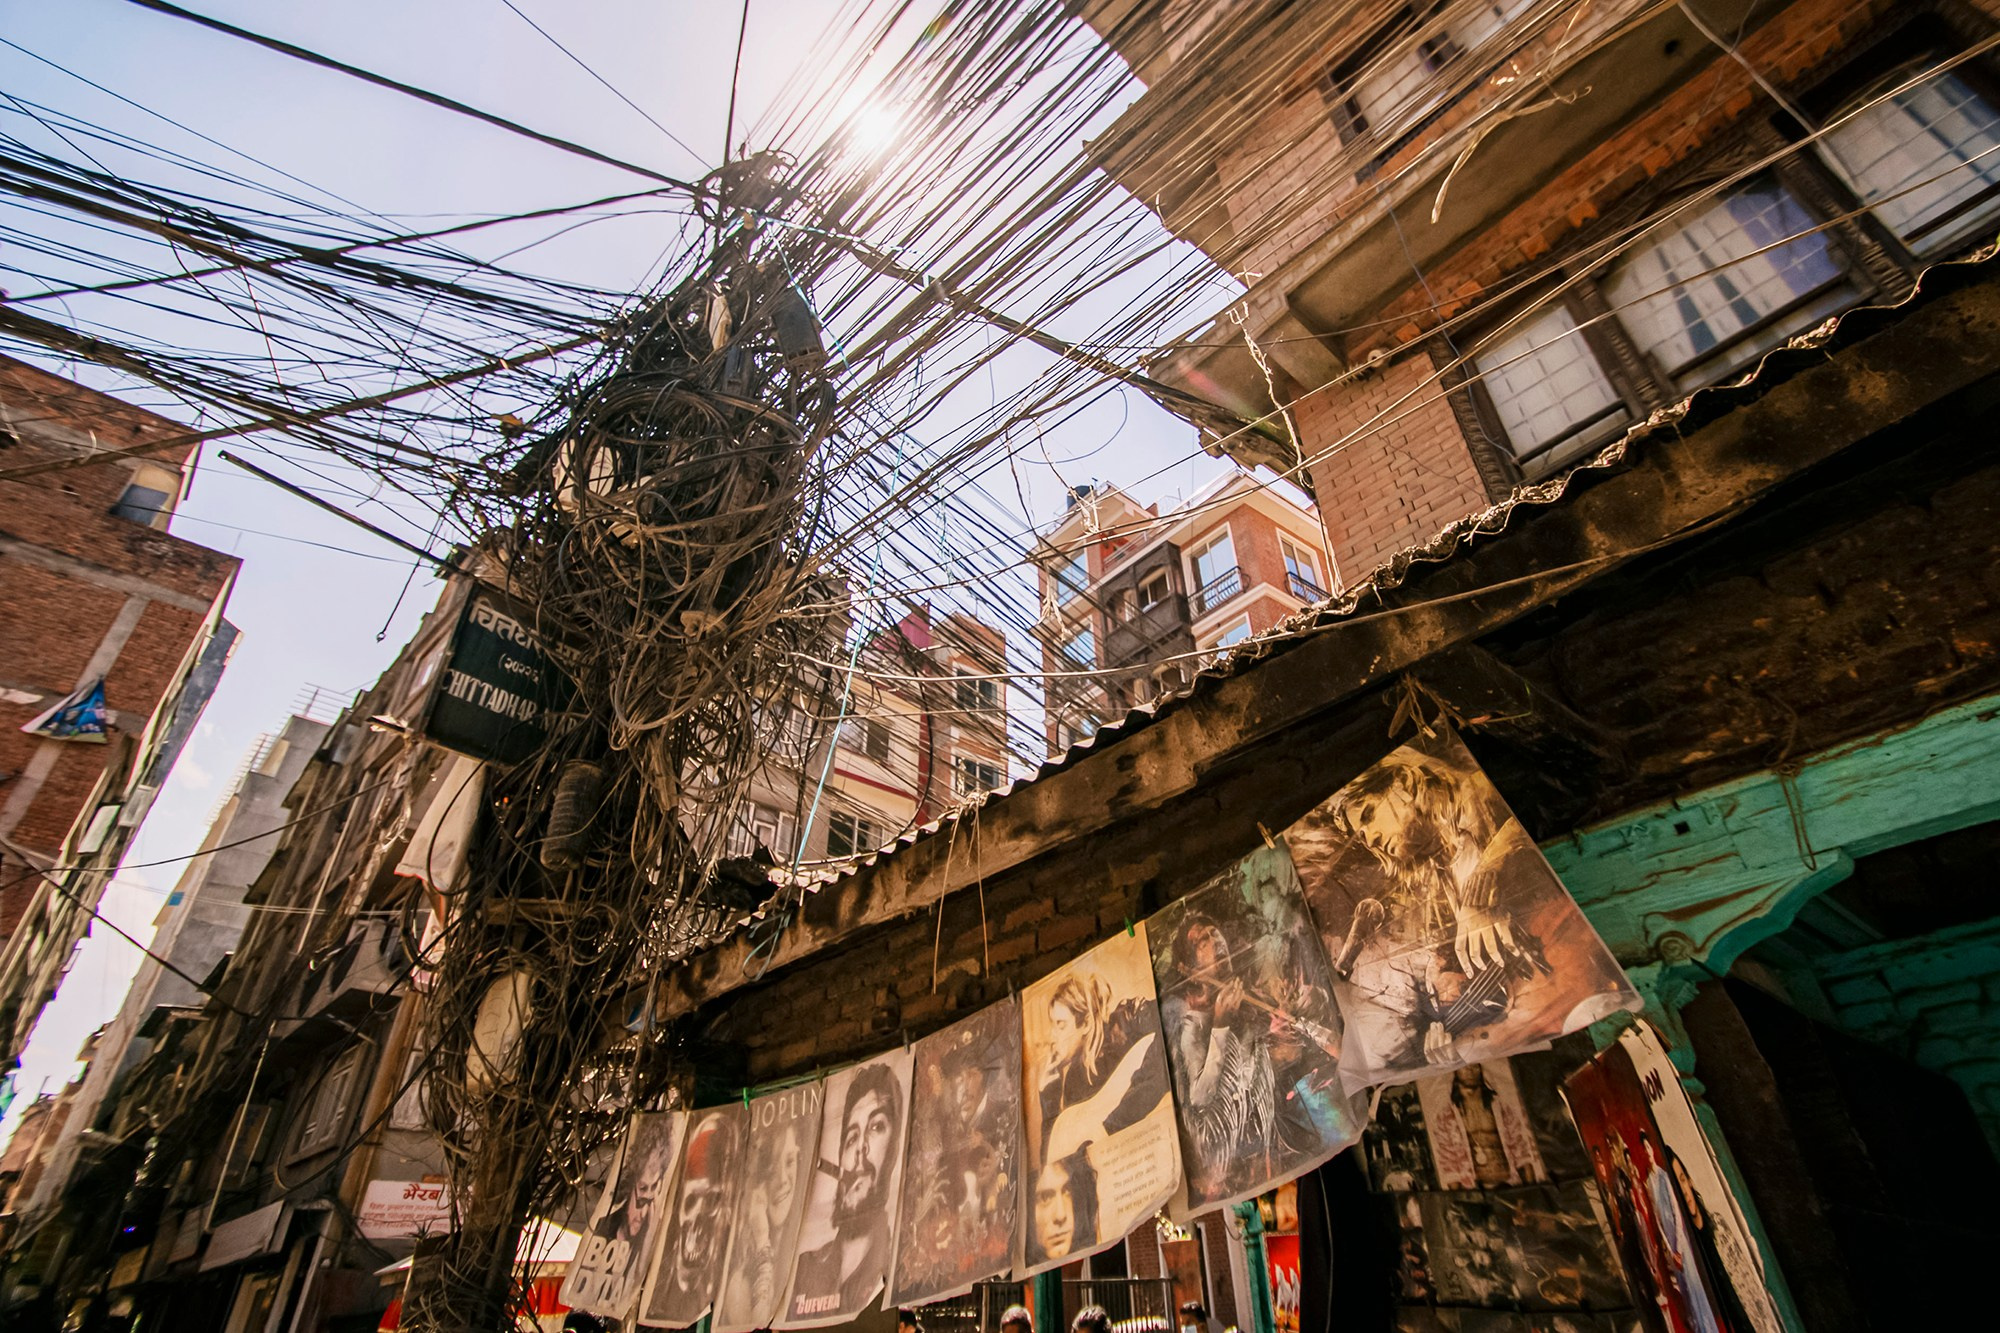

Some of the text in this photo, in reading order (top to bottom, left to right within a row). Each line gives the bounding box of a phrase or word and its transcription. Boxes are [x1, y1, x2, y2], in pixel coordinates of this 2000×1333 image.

[440, 669, 537, 725] CHITTADHAR
[752, 1087, 822, 1131] JOPLIN
[582, 1235, 630, 1274] BOB
